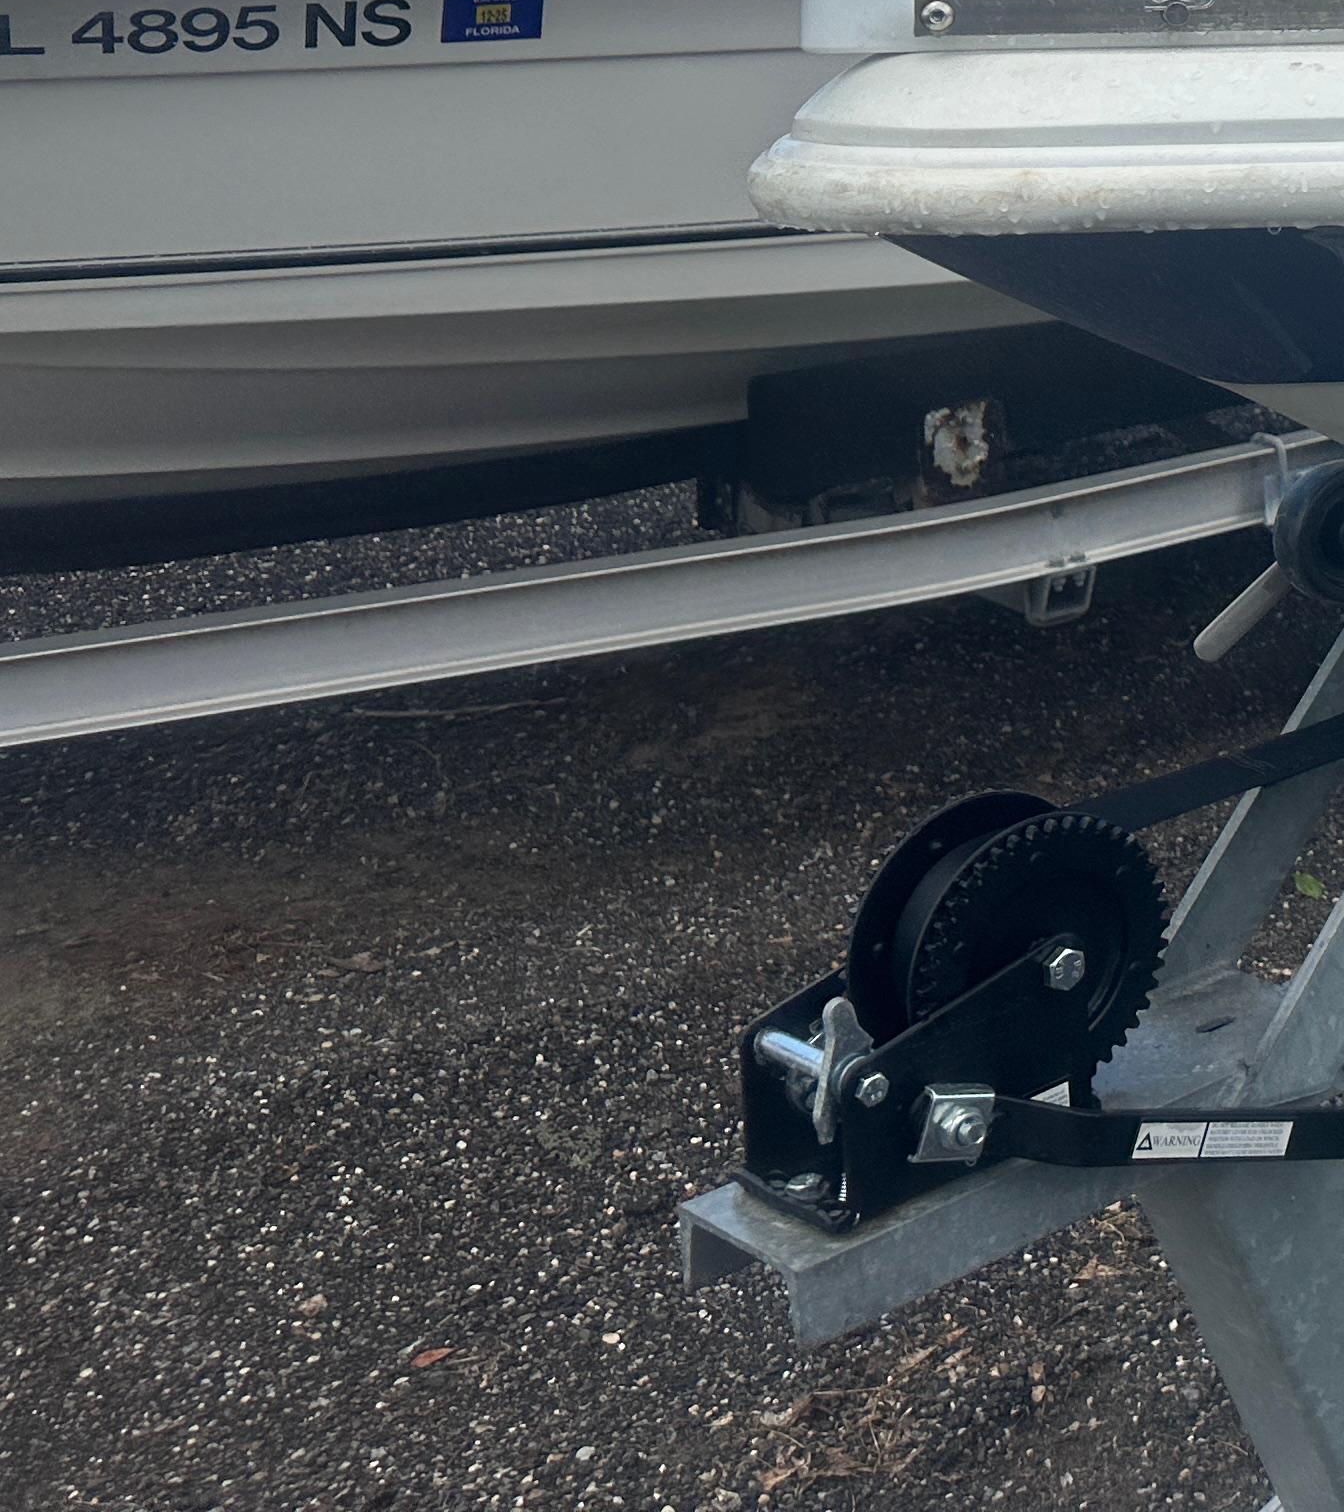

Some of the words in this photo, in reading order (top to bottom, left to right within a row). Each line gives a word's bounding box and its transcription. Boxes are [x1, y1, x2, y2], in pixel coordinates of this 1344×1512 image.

[0, 14, 46, 56] L
[71, 4, 280, 55] 4895
[465, 25, 521, 37] FLORIDA
[1152, 1135, 1202, 1149] WARNING
